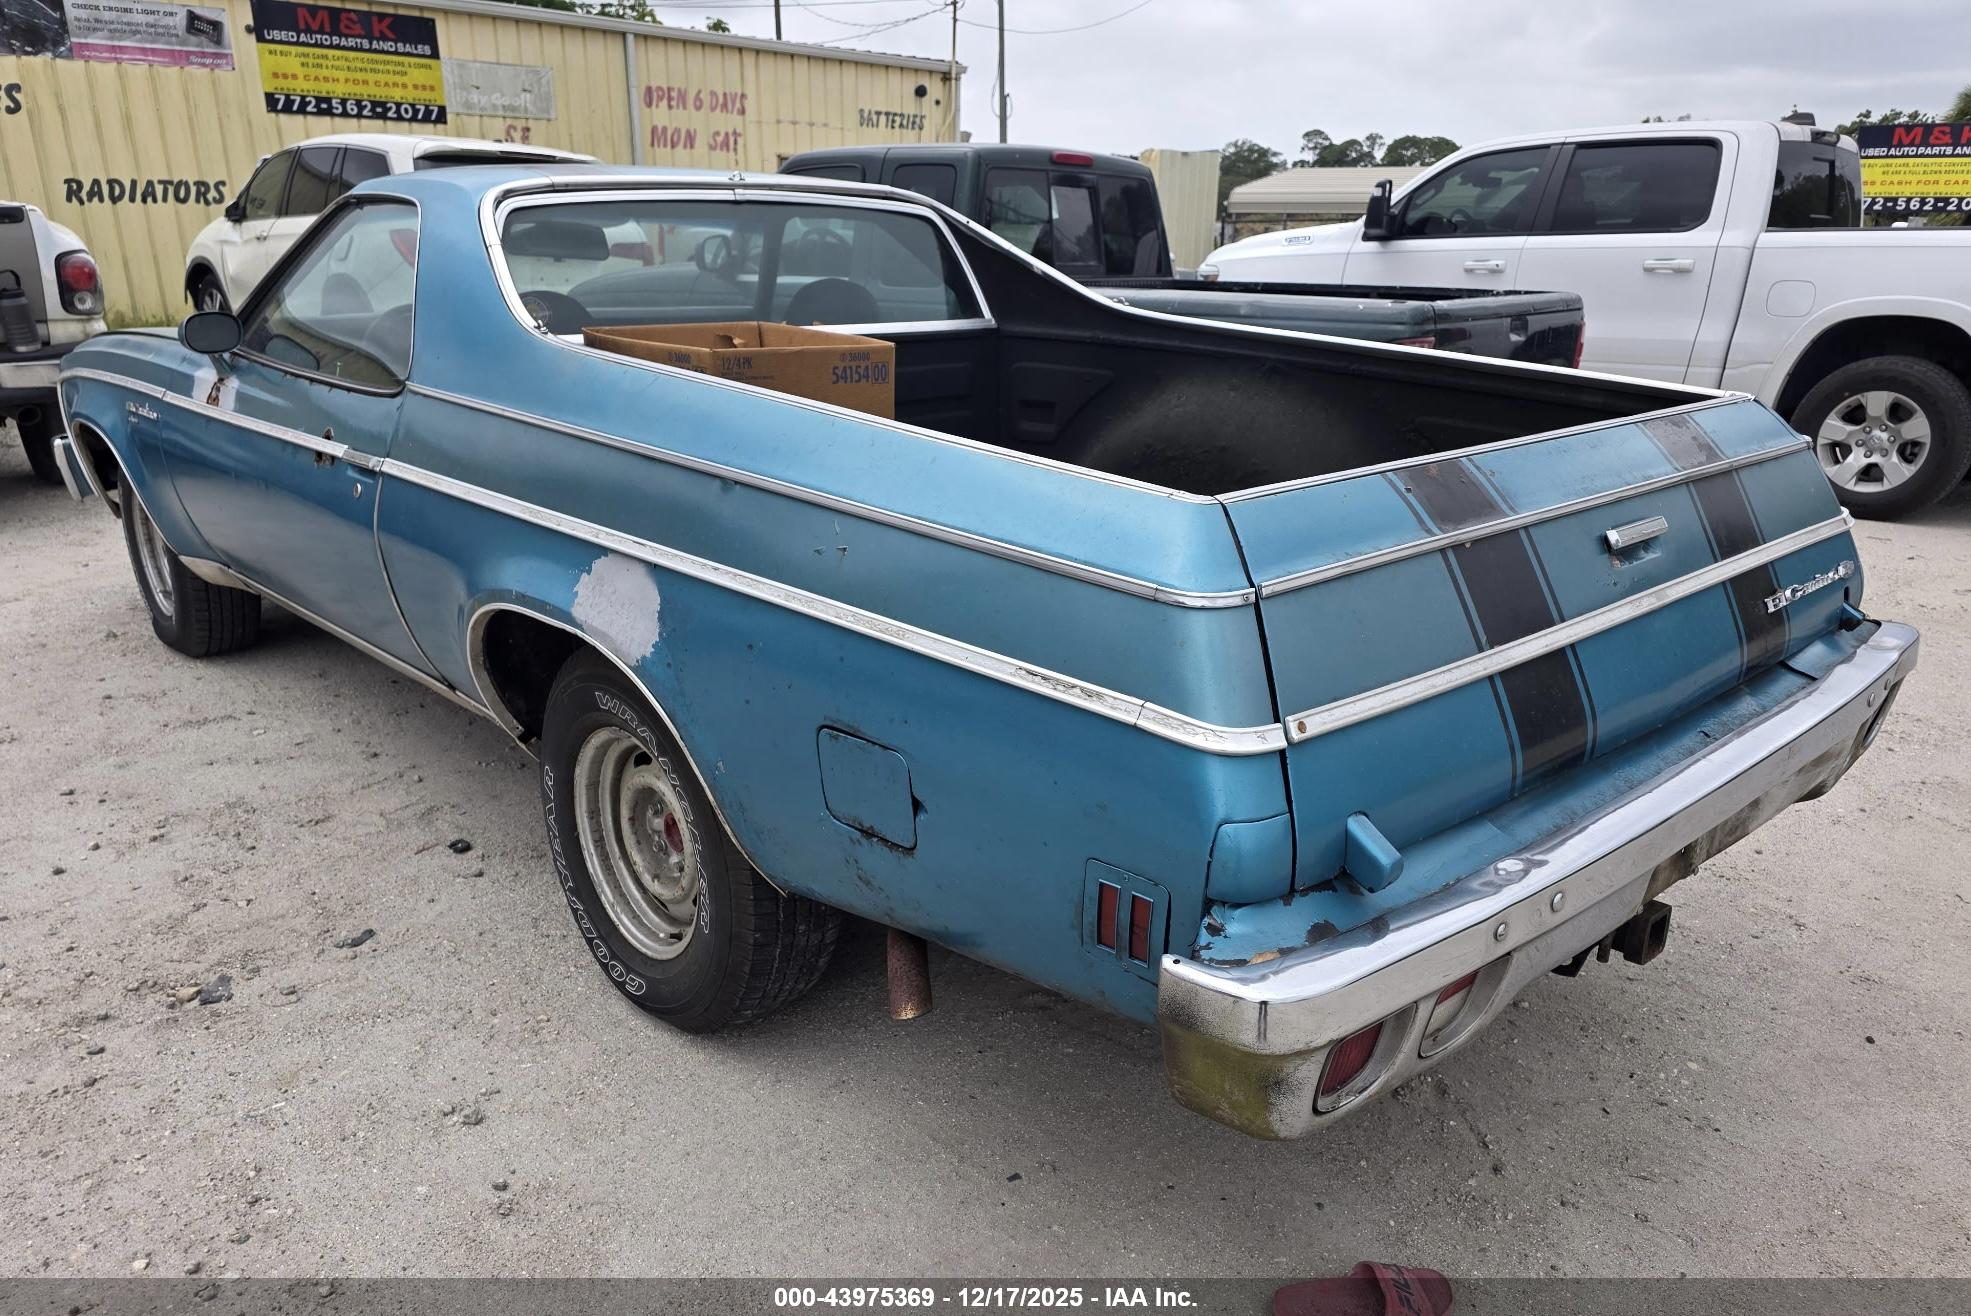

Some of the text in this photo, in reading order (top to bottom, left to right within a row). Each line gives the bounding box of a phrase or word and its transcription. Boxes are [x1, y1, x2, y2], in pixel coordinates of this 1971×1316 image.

[71, 3, 100, 12] CHECK
[102, 6, 134, 15] ENGINE
[136, 8, 161, 17] LIGHT
[297, 7, 397, 39] M & K
[264, 29, 432, 55] USED AUTO PARTS AND SALES
[303, 74, 340, 83] CASH
[344, 77, 369, 86] FOR
[374, 79, 409, 90] CARS
[273, 94, 439, 121] 772-562-2077
[643, 85, 748, 116] OPEN 6 DAYS
[858, 108, 927, 131] BATTERIES
[650, 125, 743, 152] MON SAT
[1892, 126, 1924, 145] M
[1929, 125, 1953, 145] &
[1861, 147, 1888, 156] USED
[1888, 147, 1918, 156] AUTO
[1918, 146, 1953, 155] PARTS
[63, 178, 227, 207] RADIATORS
[544, 766, 646, 995] GOODYEAR
